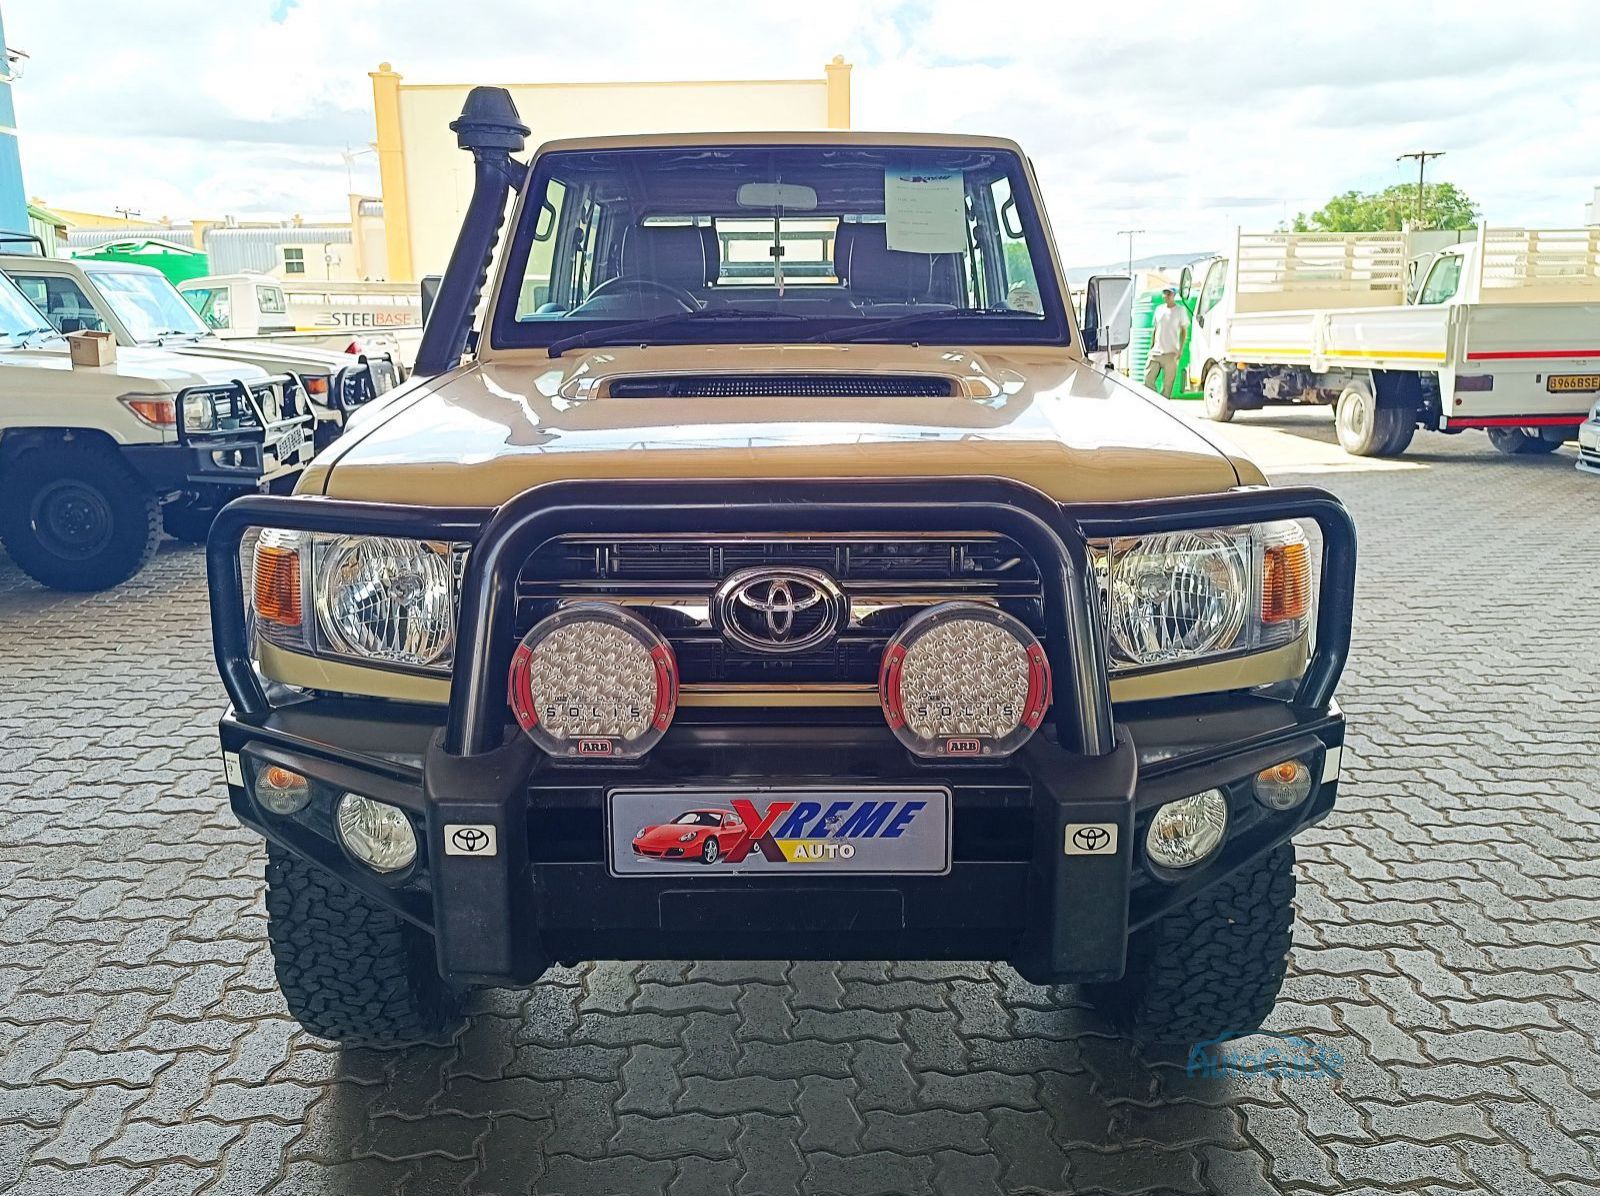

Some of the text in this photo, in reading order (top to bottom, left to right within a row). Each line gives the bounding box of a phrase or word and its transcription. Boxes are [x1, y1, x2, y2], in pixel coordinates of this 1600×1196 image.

[332, 312, 412, 327] STEELBASE
[546, 707, 640, 718] SOLIS
[918, 706, 1013, 717] SOLIS
[583, 742, 608, 752] ARB
[951, 742, 976, 752] ARB
[794, 844, 856, 859] AUTO
